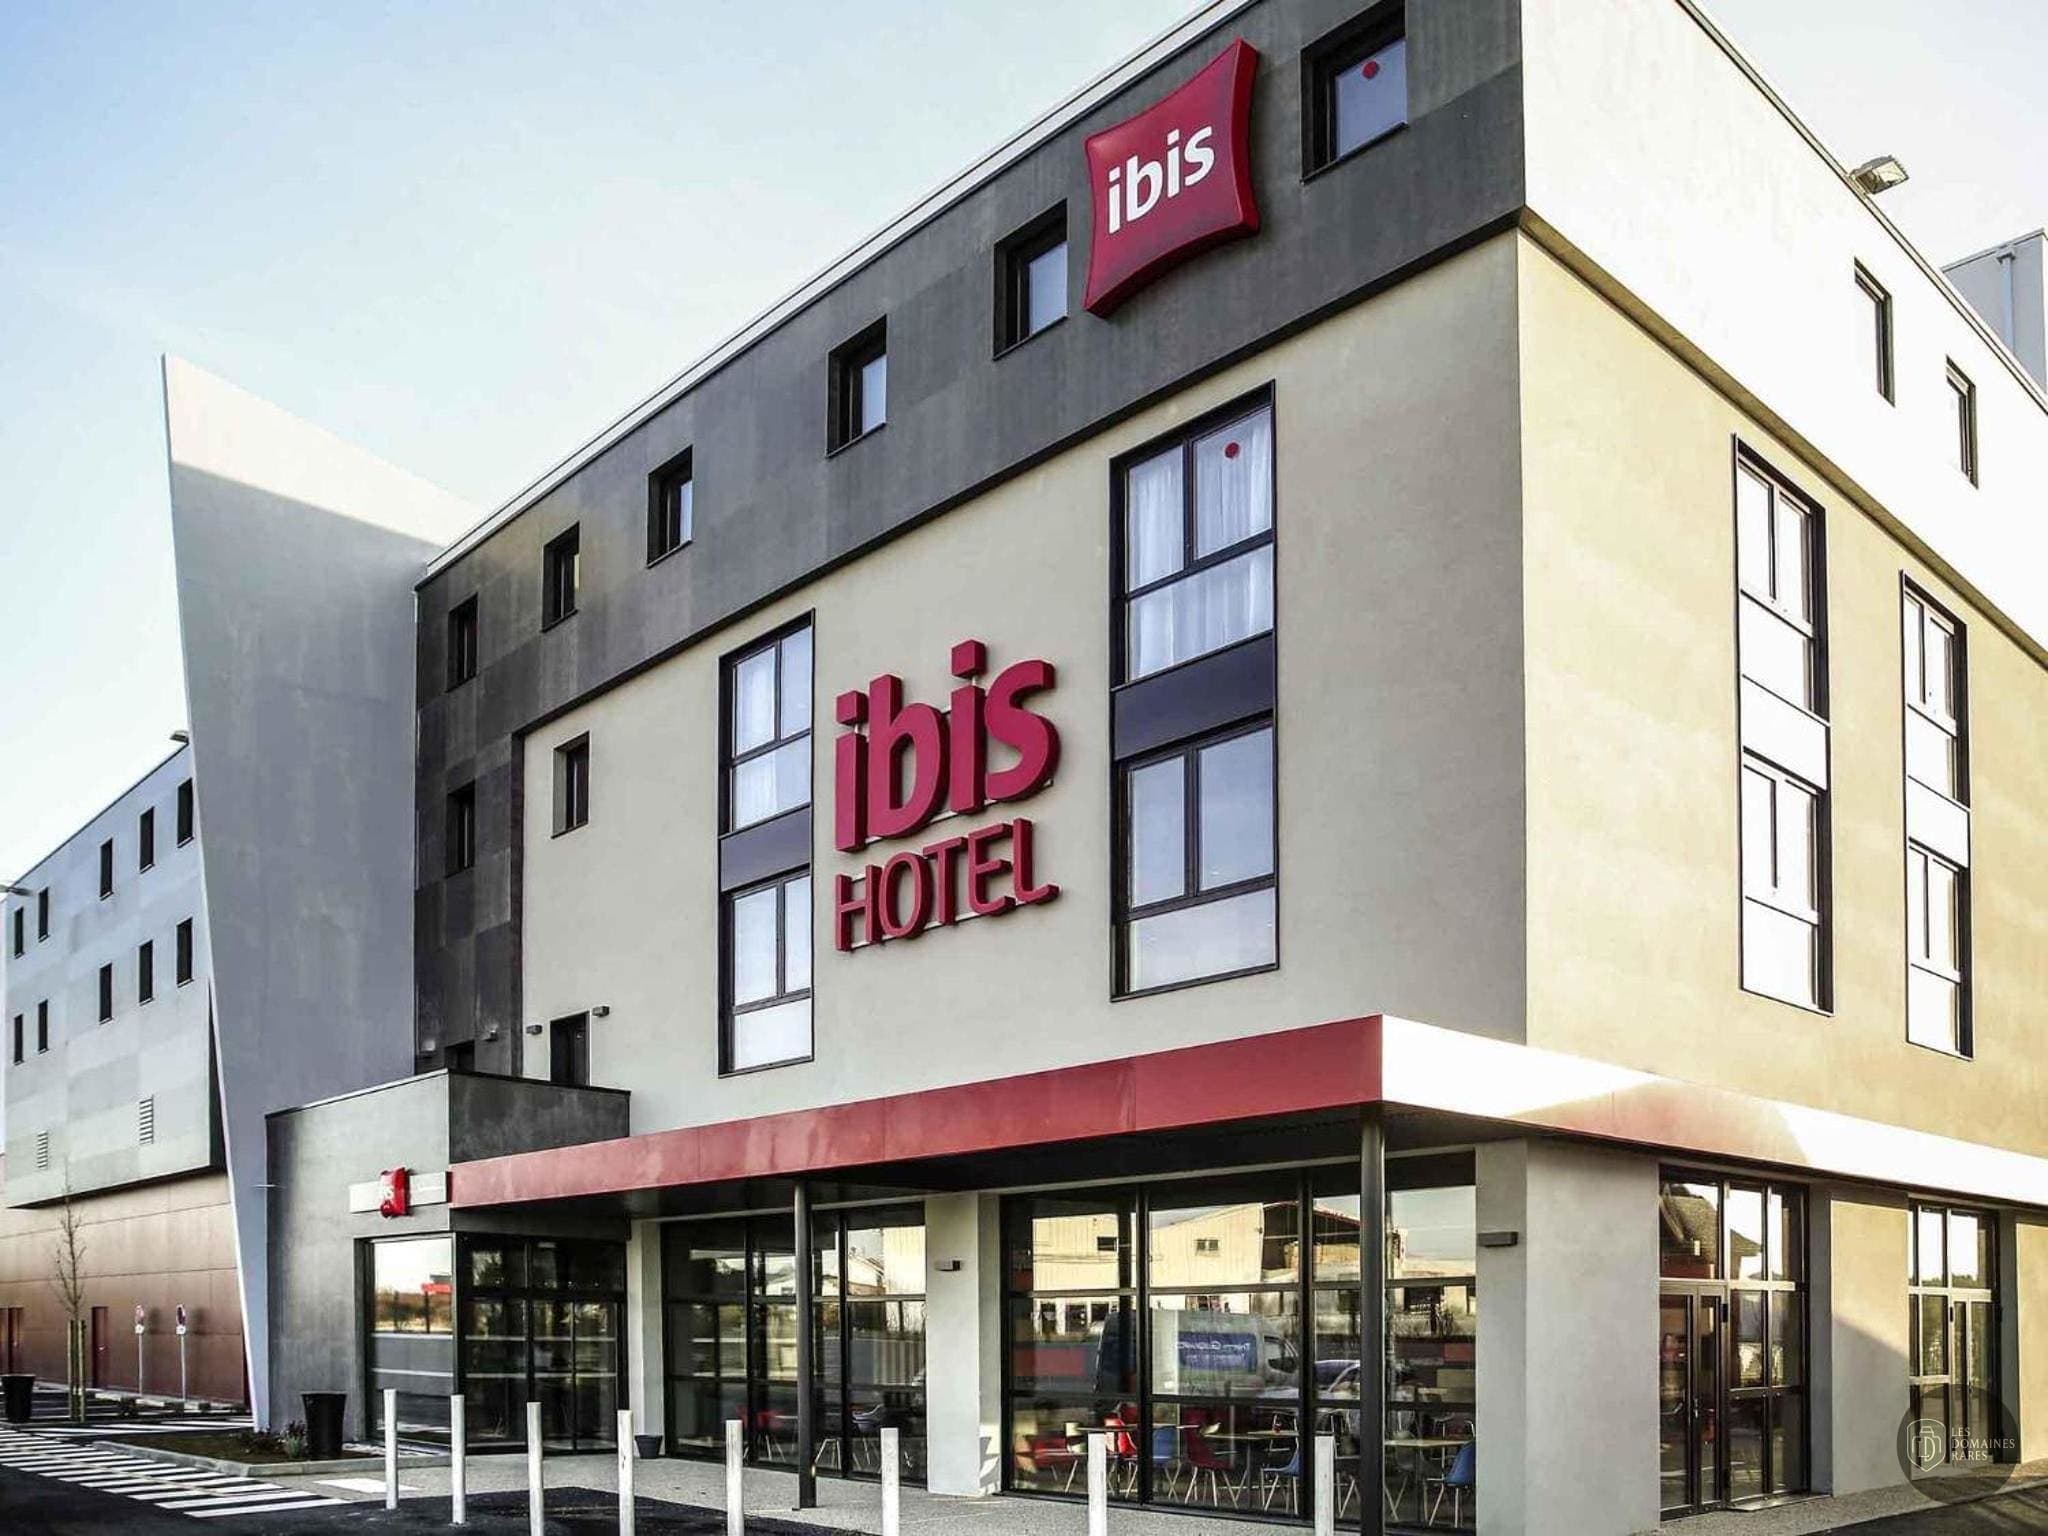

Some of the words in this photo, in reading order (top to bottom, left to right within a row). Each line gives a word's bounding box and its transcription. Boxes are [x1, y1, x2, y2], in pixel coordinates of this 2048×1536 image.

[1108, 126, 1215, 234] ibis
[835, 639, 1061, 852] ibis
[835, 818, 1062, 952] HOTEL
